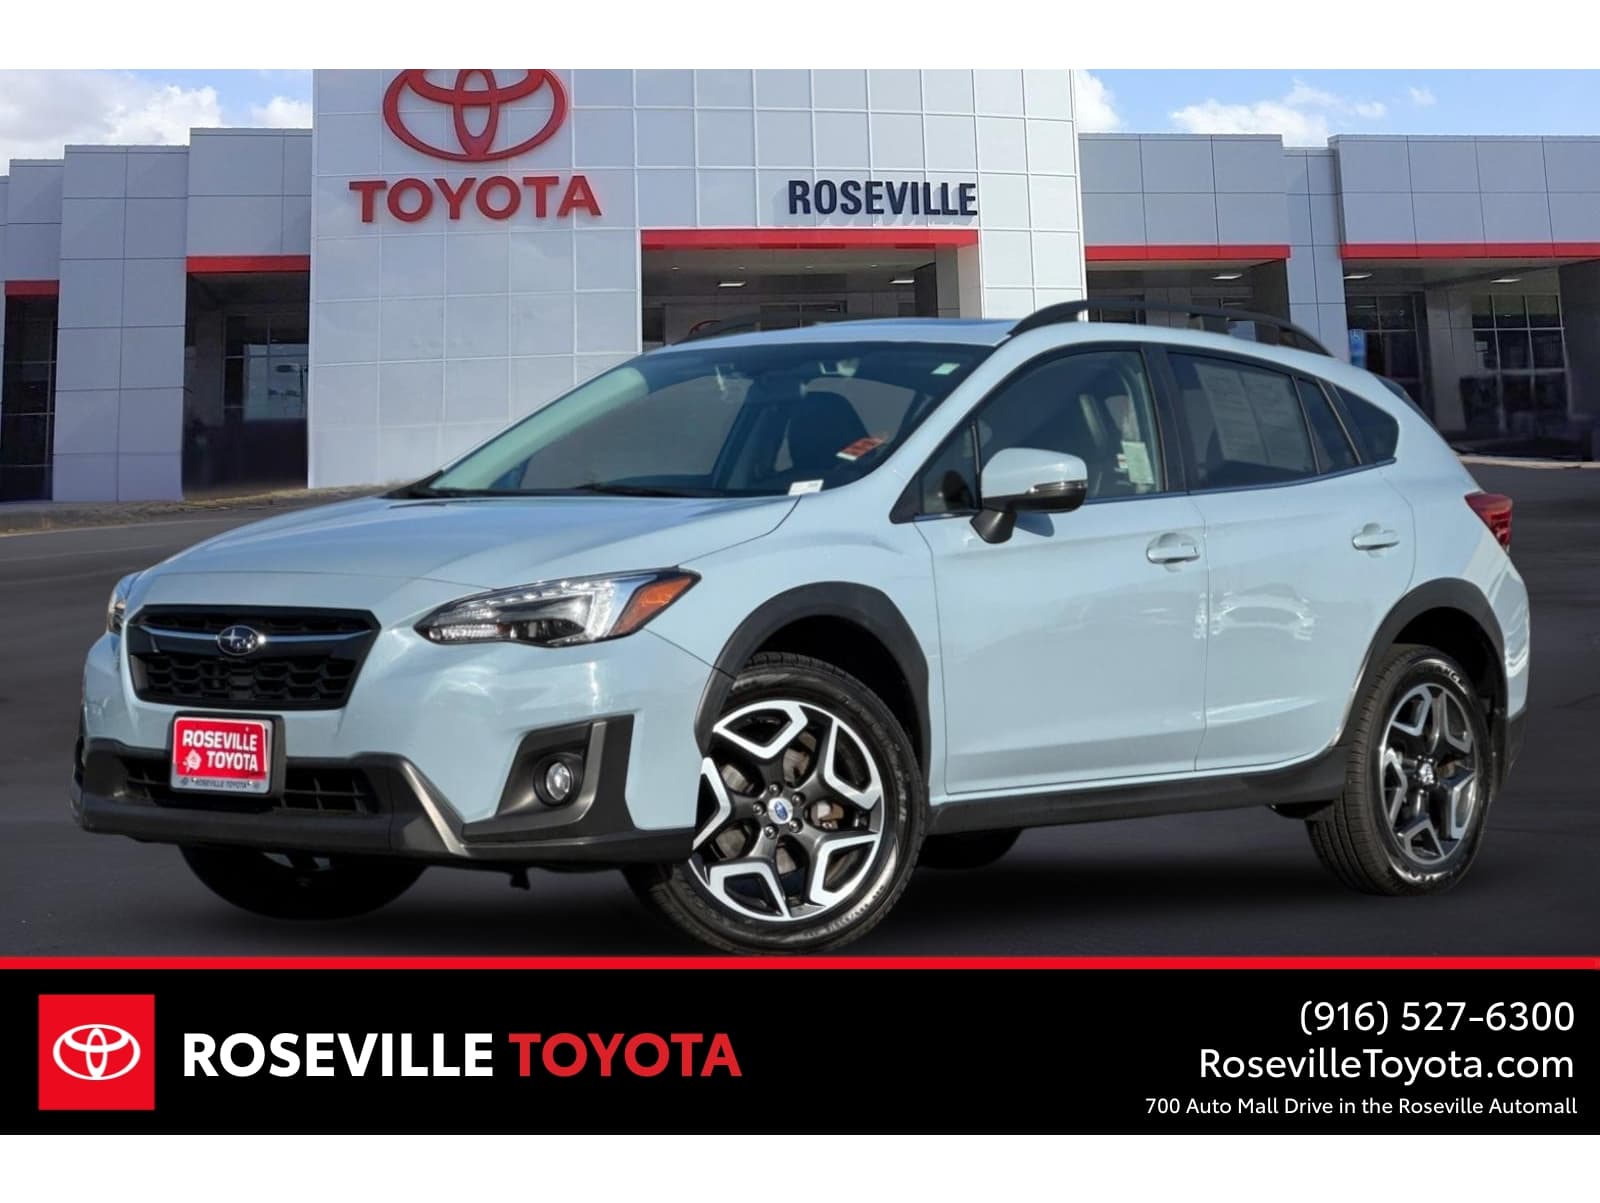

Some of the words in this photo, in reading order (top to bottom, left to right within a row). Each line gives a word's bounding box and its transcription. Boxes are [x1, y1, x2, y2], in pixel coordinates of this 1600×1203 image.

[349, 174, 602, 224] TOYOTA
[788, 179, 978, 217] ROSEVILLE
[182, 729, 258, 752] ROSEVILLE
[206, 751, 259, 773] TOYOTA
